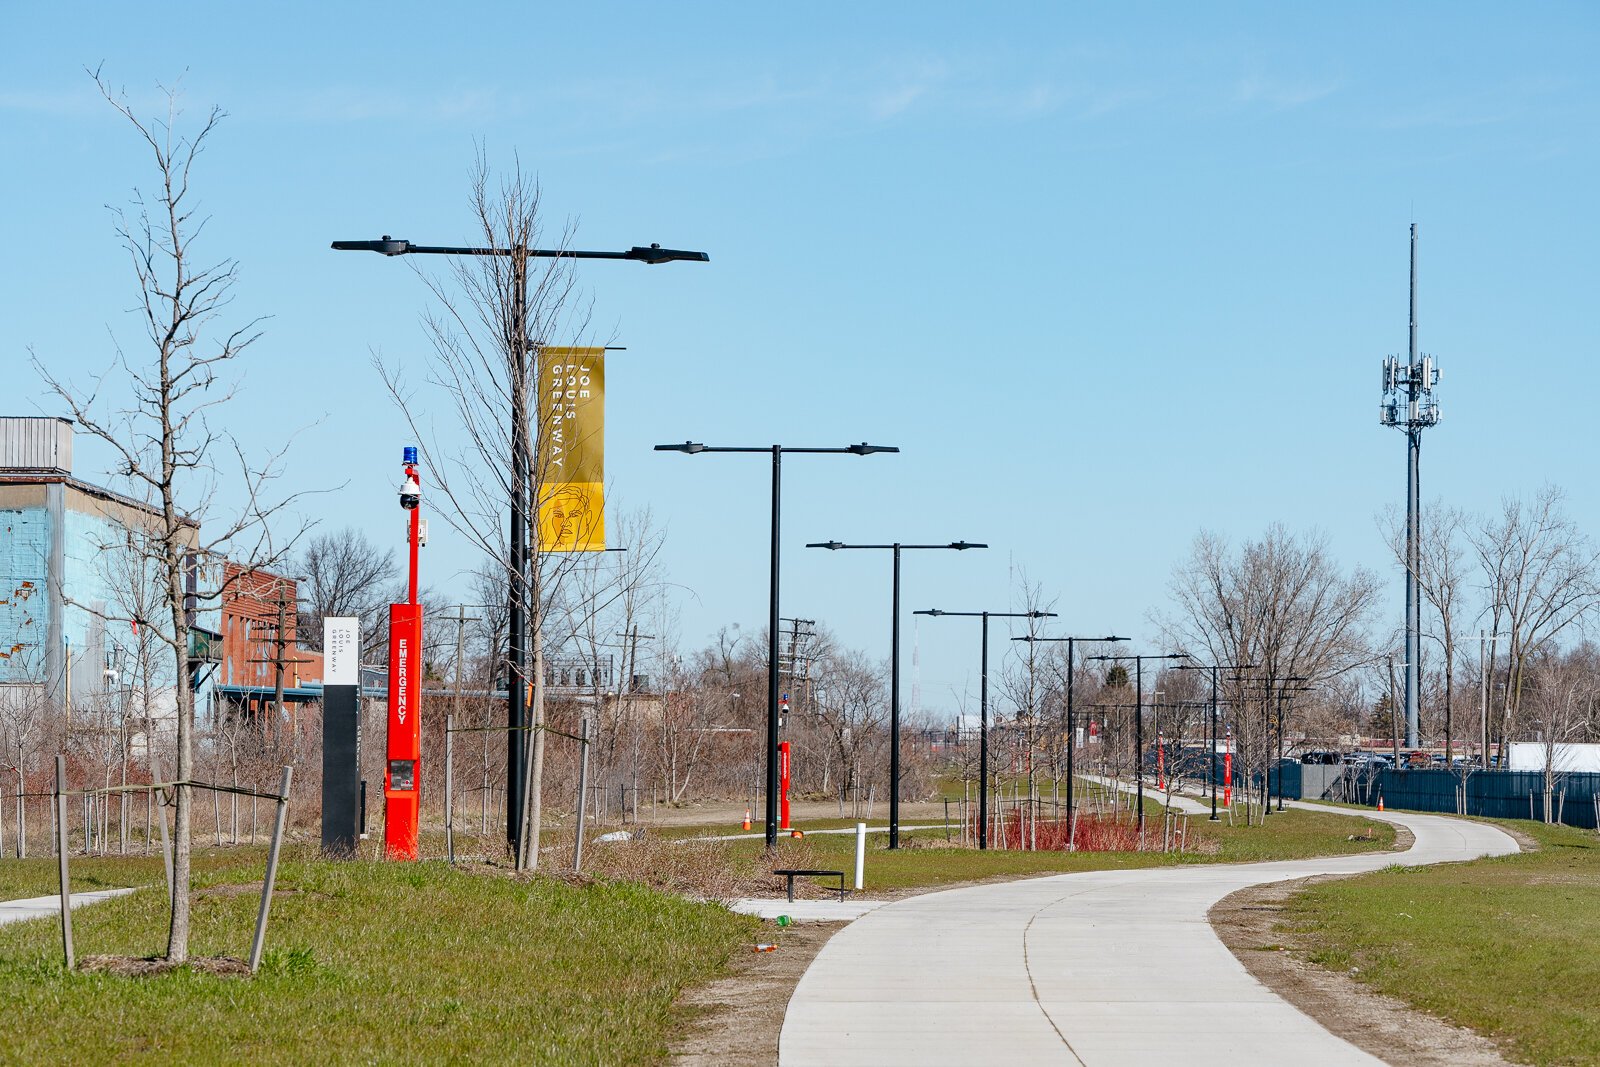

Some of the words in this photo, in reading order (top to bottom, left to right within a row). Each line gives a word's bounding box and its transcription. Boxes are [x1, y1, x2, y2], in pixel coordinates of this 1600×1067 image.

[552, 365, 562, 467] GREENWAY
[566, 365, 576, 419] LOUIS
[580, 365, 590, 398] JOE
[398, 639, 407, 725] EMERGENCY
